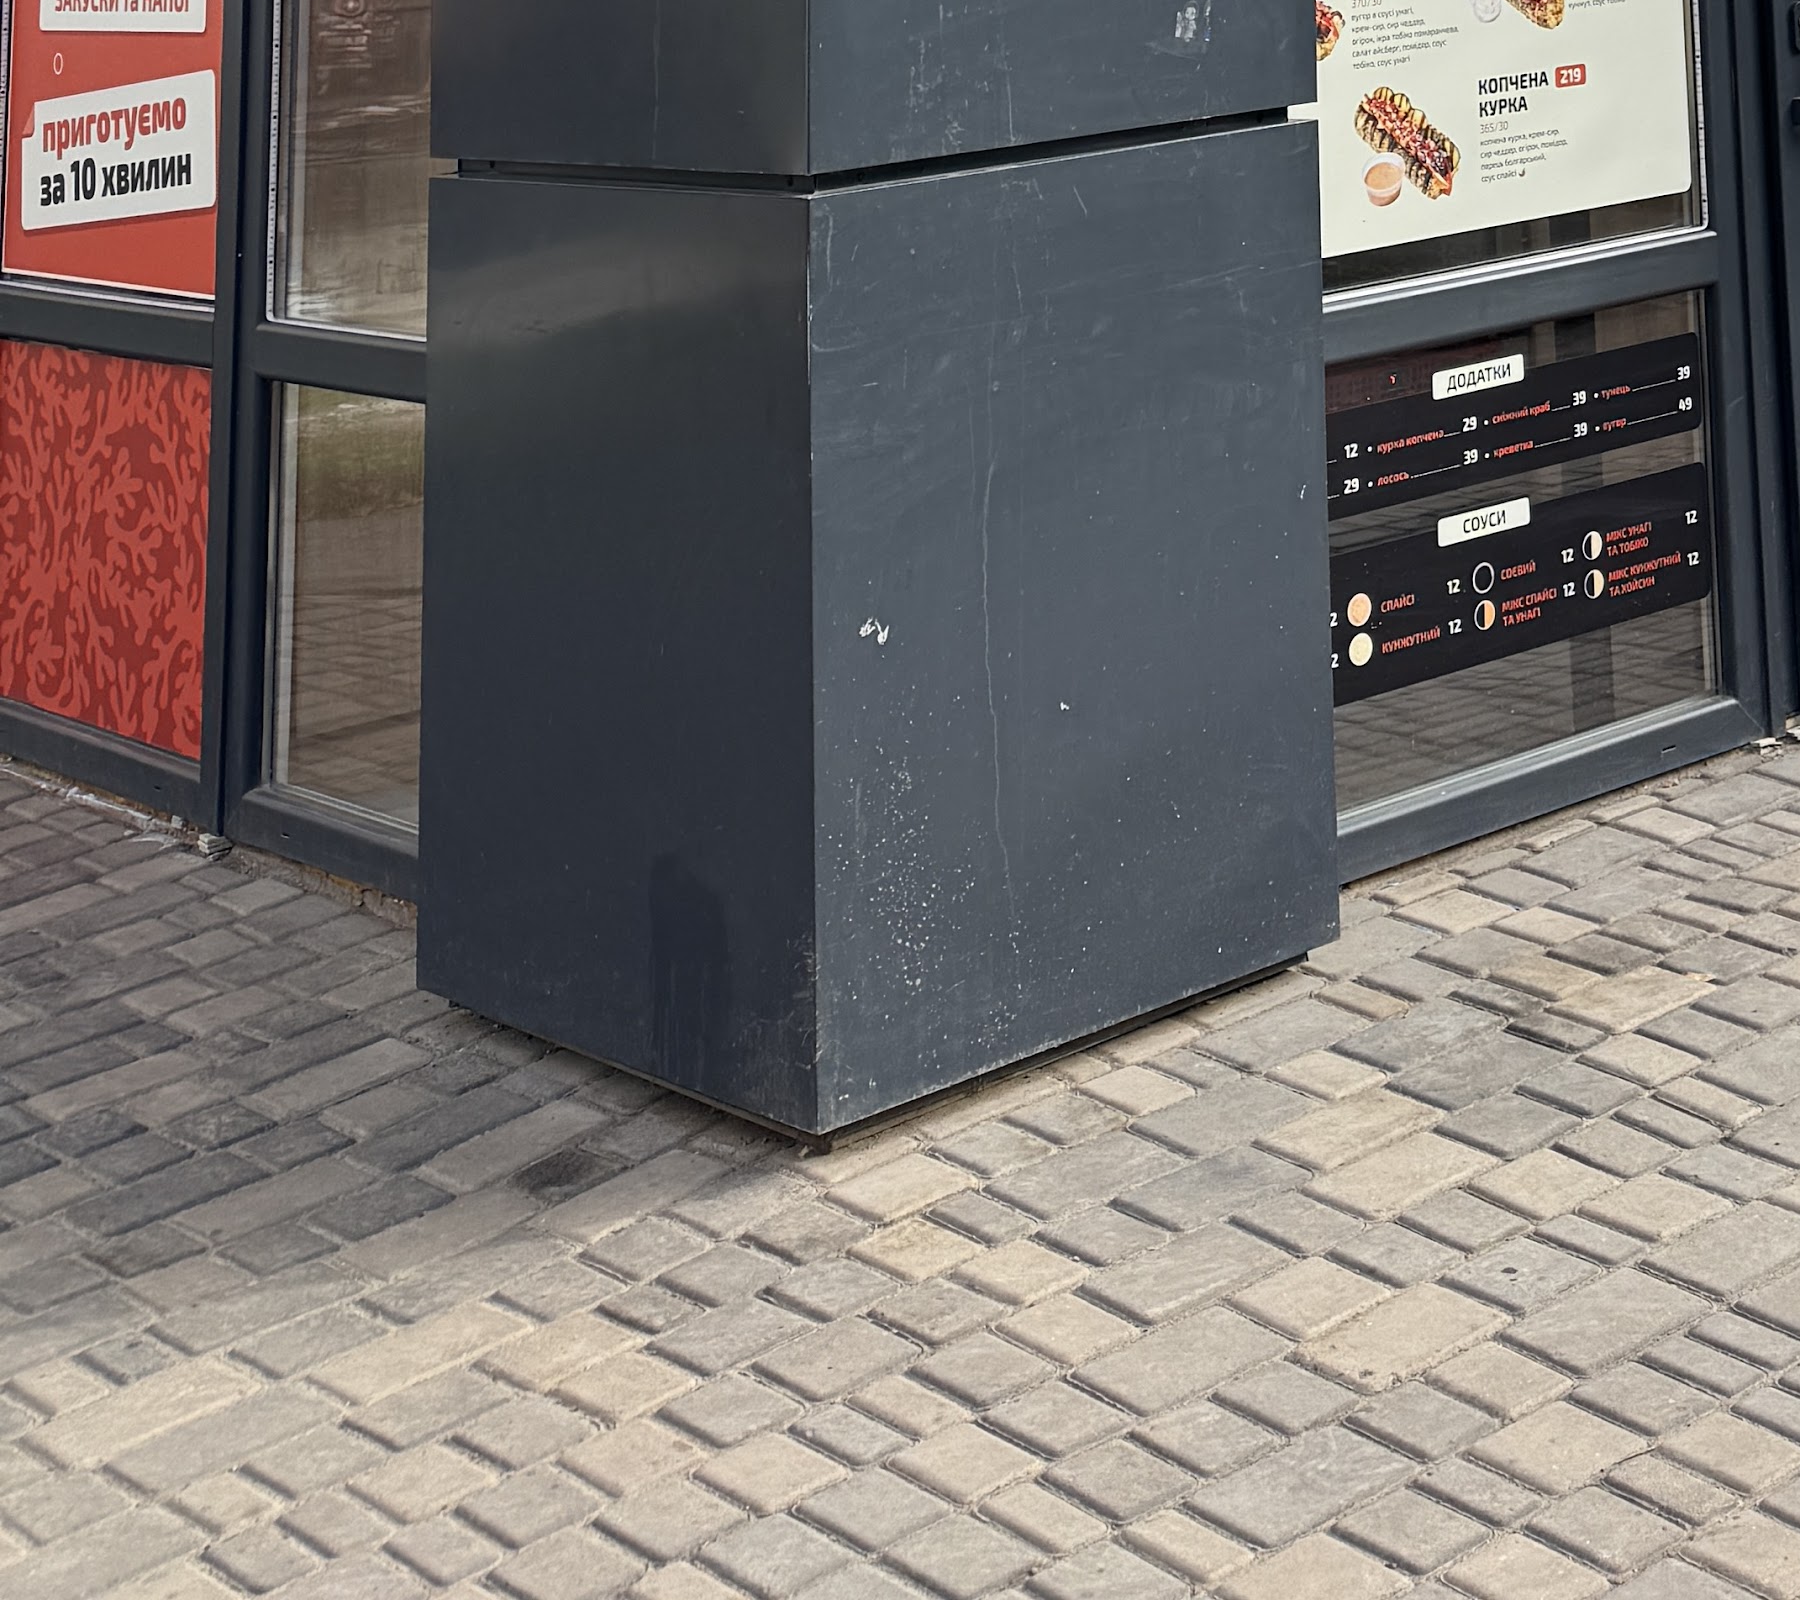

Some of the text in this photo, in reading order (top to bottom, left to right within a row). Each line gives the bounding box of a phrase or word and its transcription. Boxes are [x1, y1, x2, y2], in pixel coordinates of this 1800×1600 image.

[1478, 68, 1581, 95] КОПЧЕНА 219
[43, 97, 187, 160] приготуємо
[1479, 97, 1528, 117] КУРКА
[40, 153, 191, 206] за 10 хвилин
[1447, 363, 1511, 392] ДОДАТКИ
[1344, 365, 1691, 459] 12 29 39 39
[1344, 397, 1693, 494] 29 39 39 49
[1463, 511, 1507, 534] СОУСИ
[1685, 510, 1698, 525] 12
[1446, 548, 1574, 595] 12 12
[1382, 552, 1699, 654] КУНЖУТНИЙ 12 12 12
